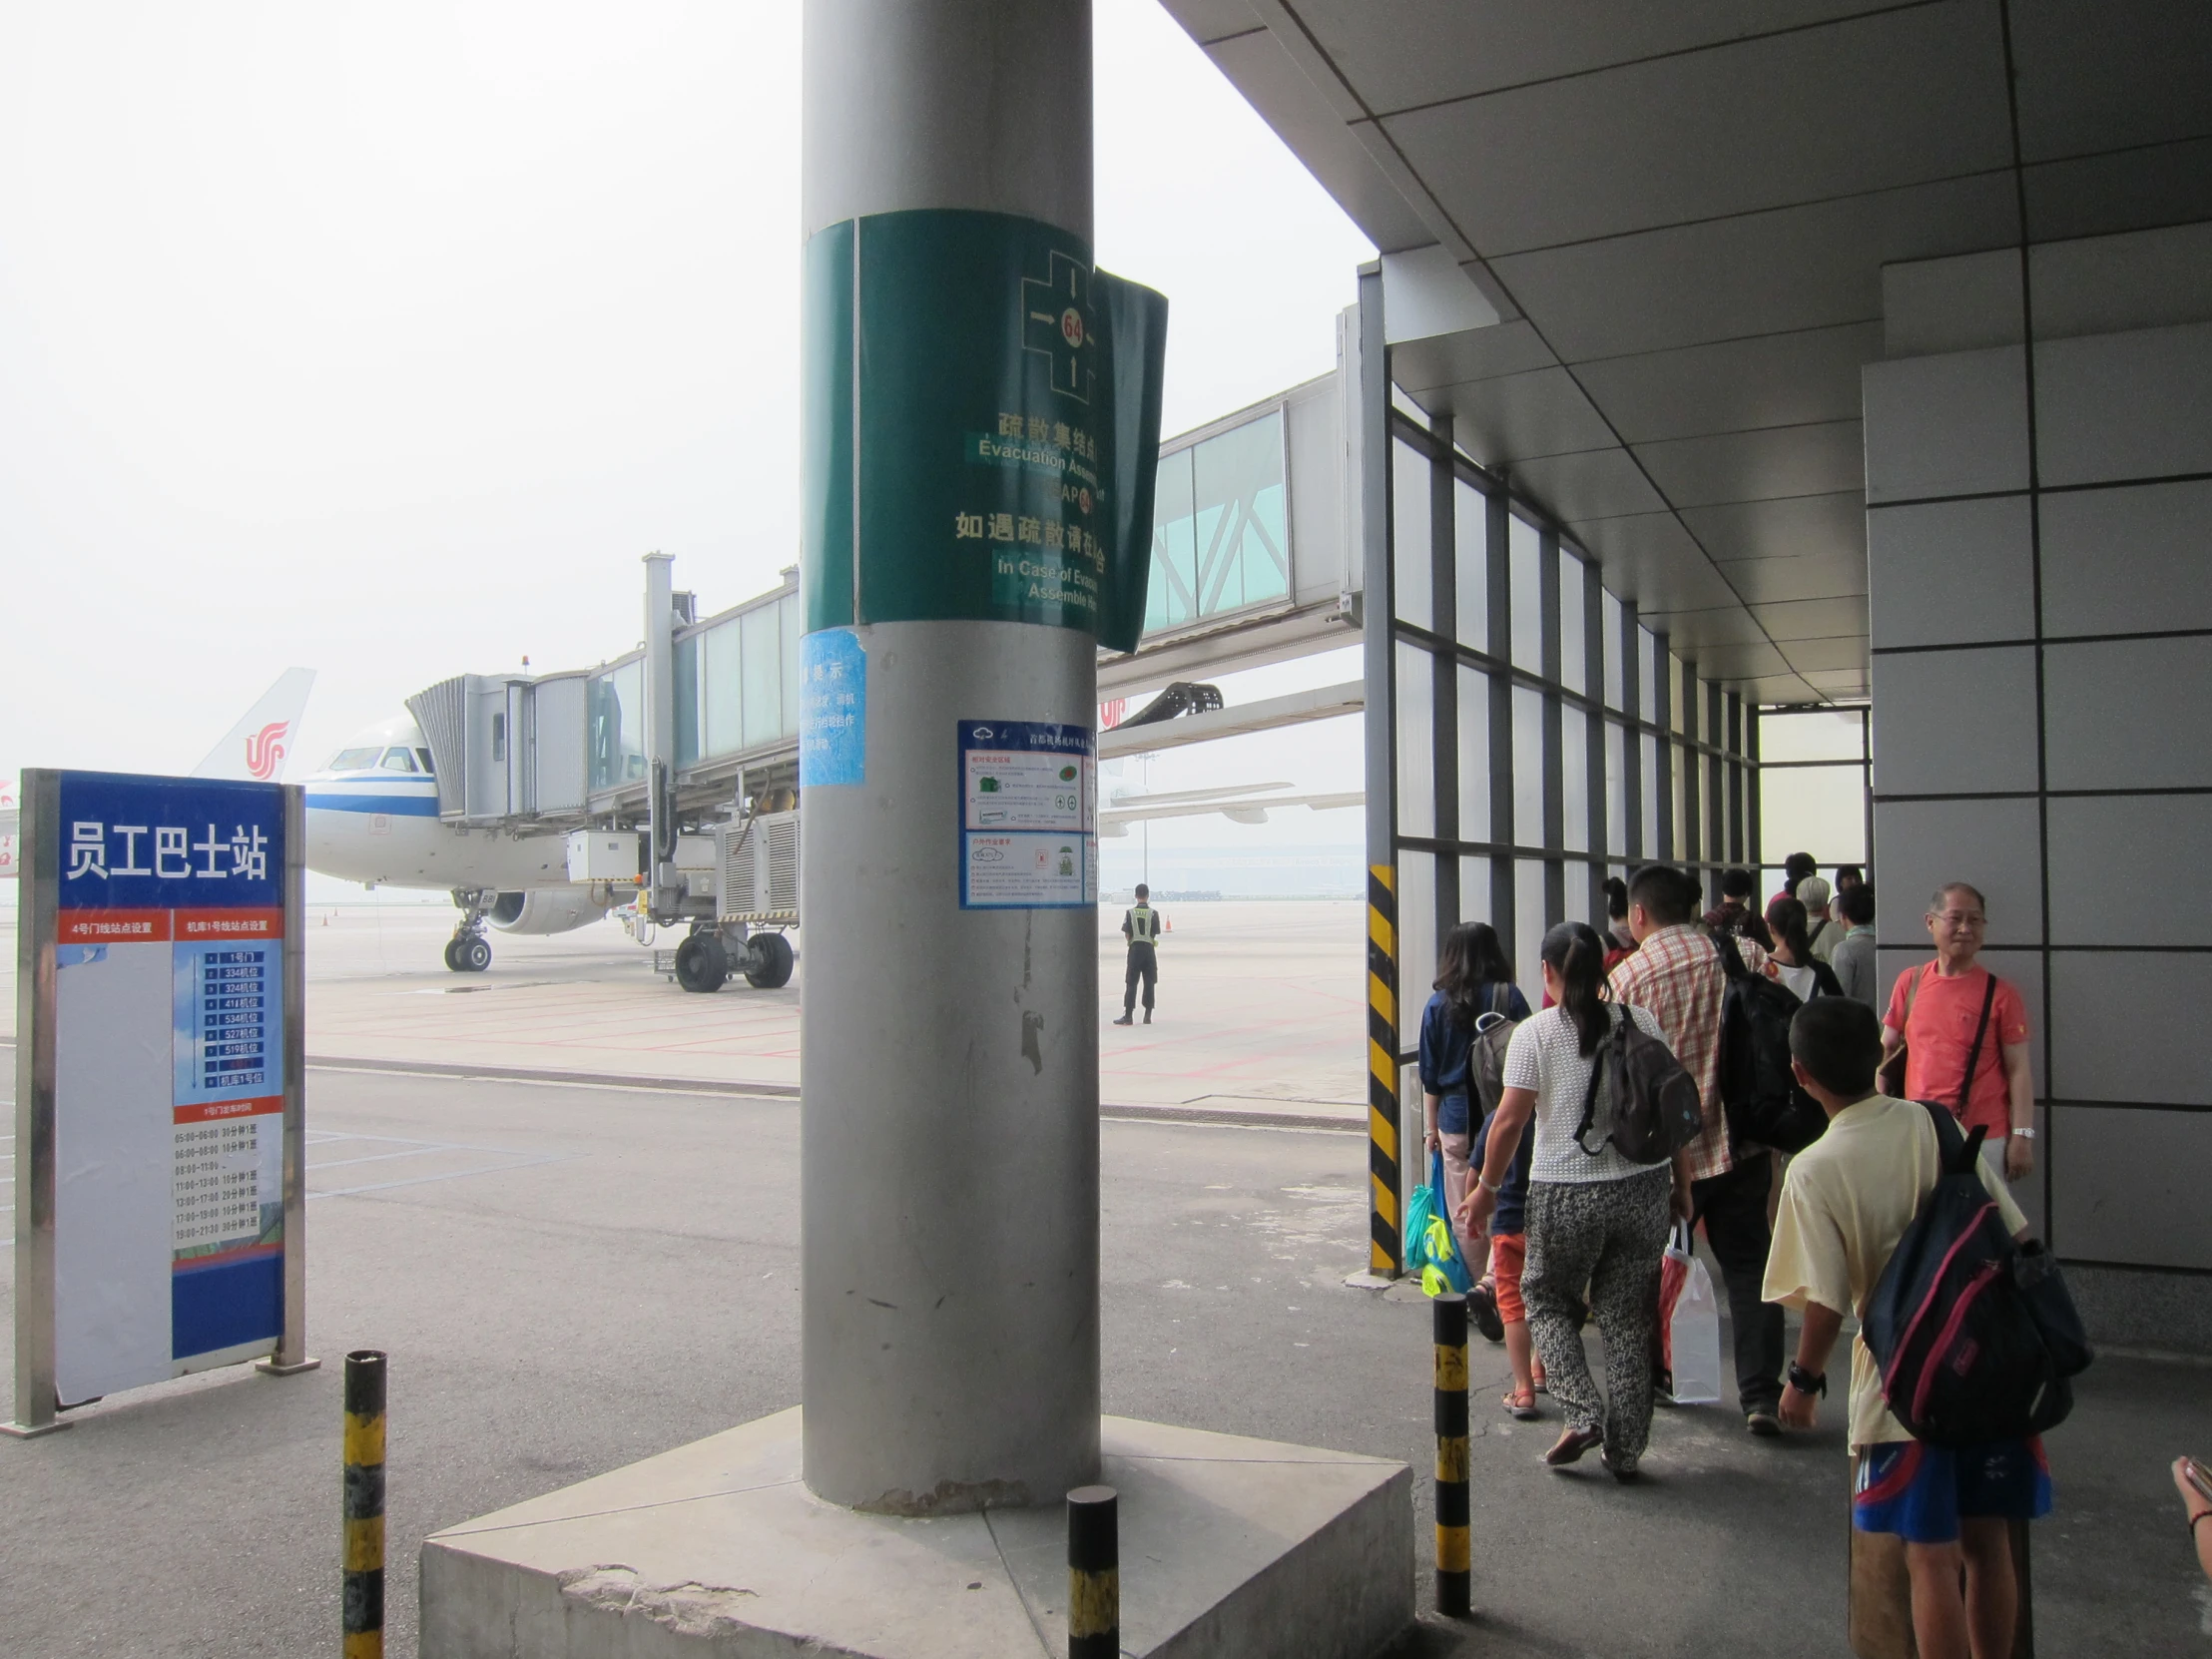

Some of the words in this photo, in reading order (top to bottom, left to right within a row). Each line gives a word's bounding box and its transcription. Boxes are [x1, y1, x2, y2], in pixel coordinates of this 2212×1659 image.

[1063, 313, 1082, 342] 64
[998, 412, 1095, 463] 疏散集结点
[978, 439, 1066, 469] Evacuation
[998, 559, 1014, 575] In
[1019, 560, 1057, 580] Case
[1060, 566, 1073, 582] of
[1028, 582, 1087, 608] Assemble
[66, 822, 269, 880] 员工巴士站
[72, 921, 153, 934] 4号门线站点设置
[187, 920, 269, 932] 机库1号线站点设置
[230, 952, 255, 963] 1号门
[225, 967, 259, 978] 334机位
[225, 982, 259, 993] 324机位
[225, 1012, 259, 1024] 534机位
[225, 1028, 259, 1039] 527机位
[225, 1043, 259, 1054] 519机位
[221, 1073, 264, 1086] 机库1号位
